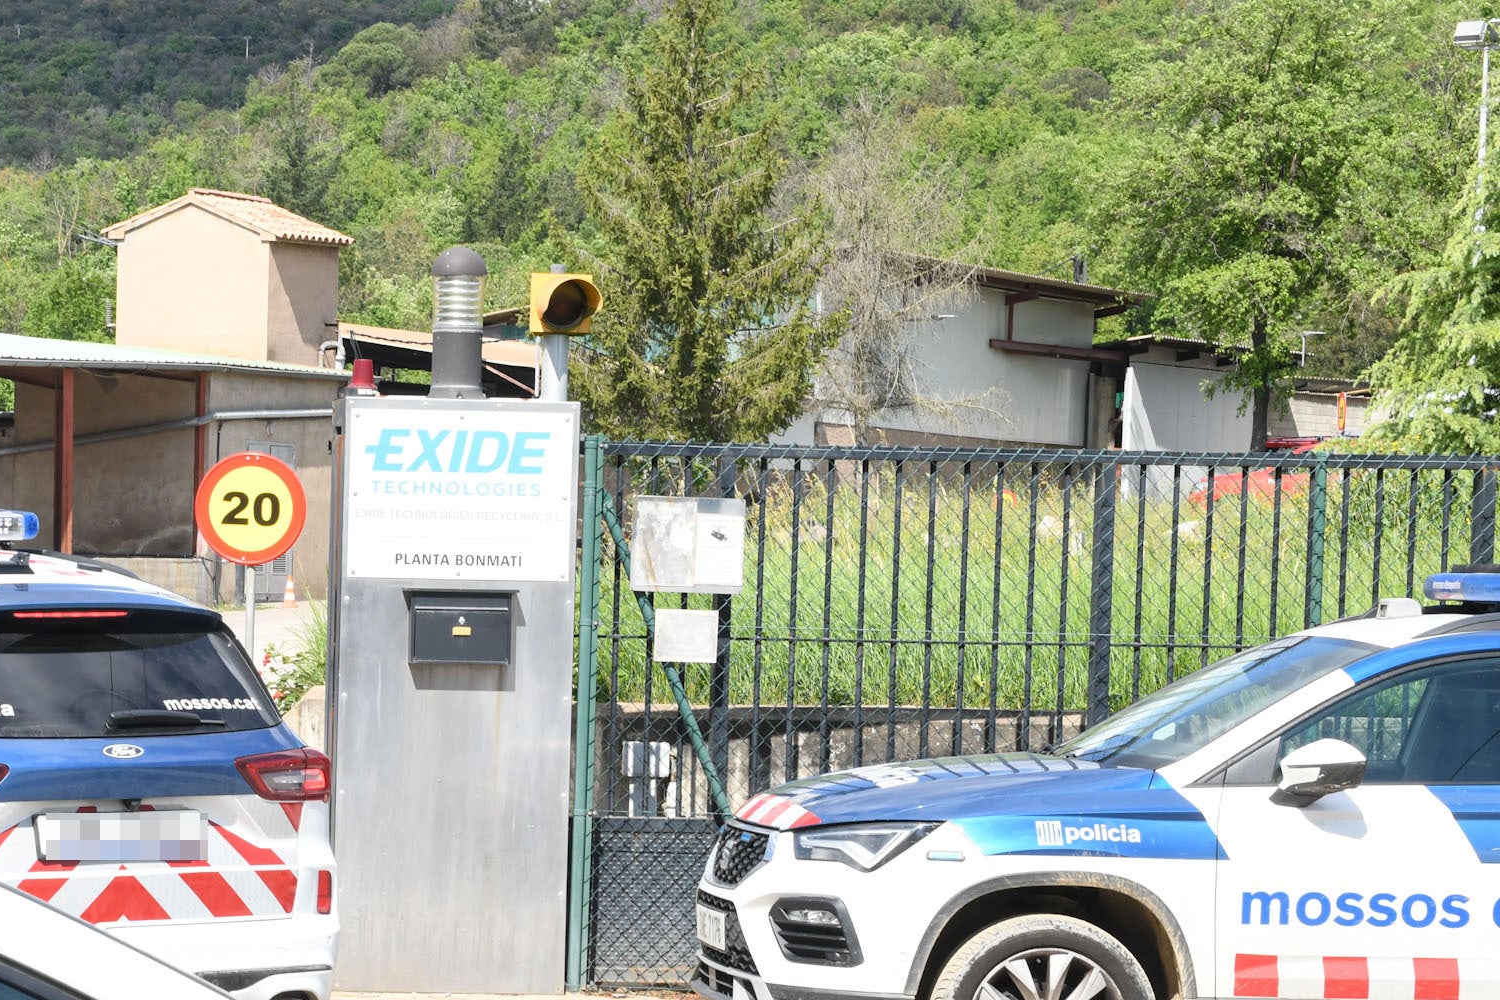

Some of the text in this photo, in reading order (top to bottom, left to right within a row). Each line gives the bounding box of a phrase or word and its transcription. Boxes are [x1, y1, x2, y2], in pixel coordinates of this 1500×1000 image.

[365, 428, 551, 475] EXIDE
[371, 479, 542, 497] TECHNOLOGIES
[221, 491, 280, 527] 20
[355, 508, 386, 519] EXIDE
[389, 508, 474, 520] TECHNOLOGIES
[395, 553, 450, 566] PLANTA
[163, 696, 262, 712] mossos.cat
[1065, 824, 1141, 844] policia
[1241, 891, 1470, 928] mossos
